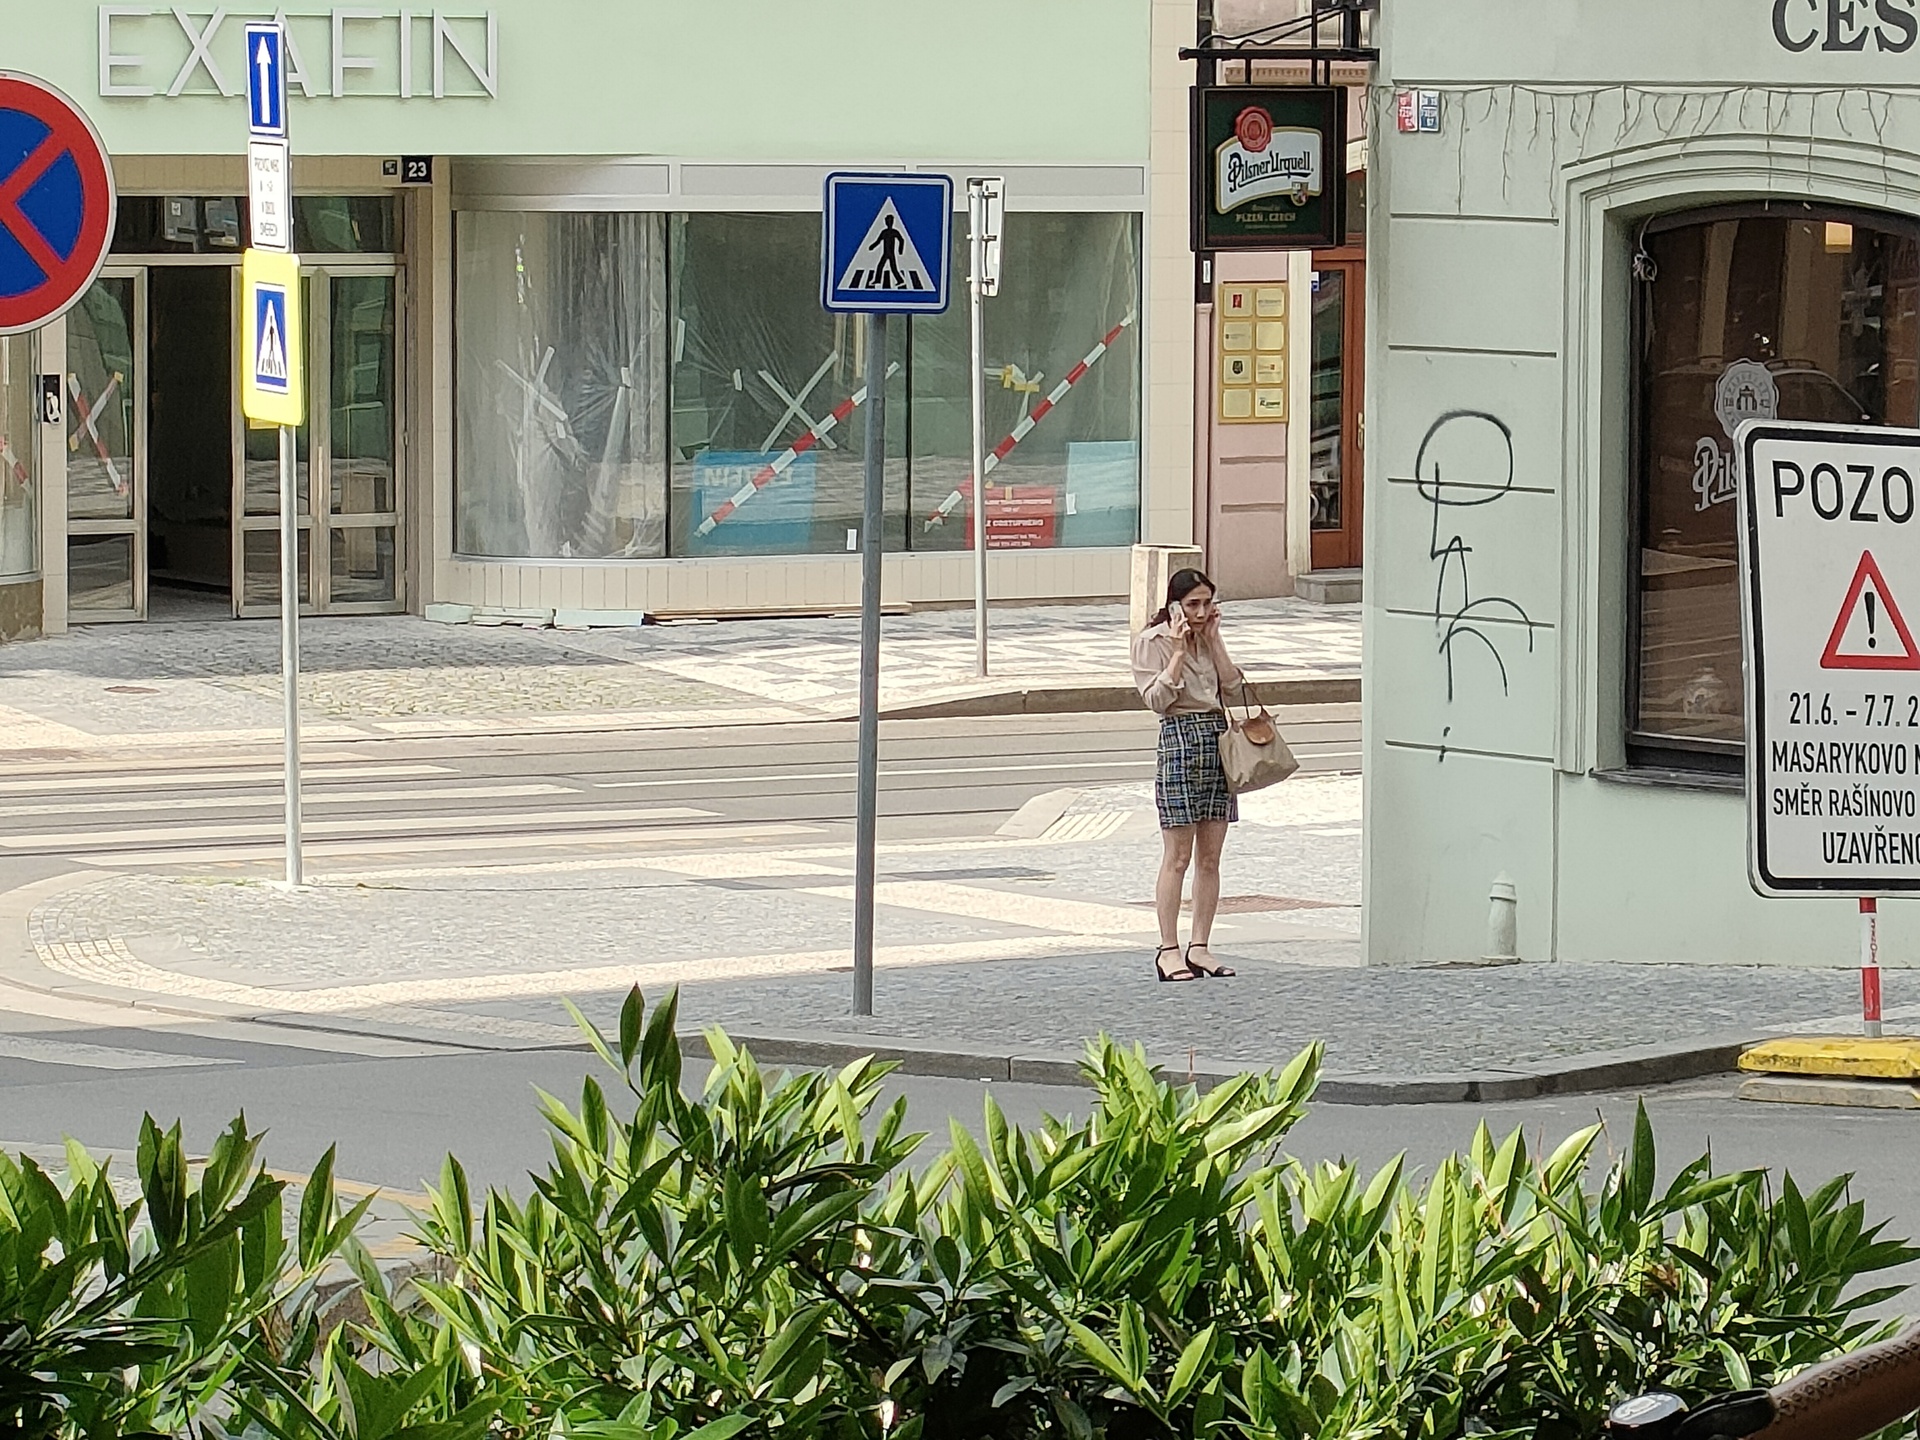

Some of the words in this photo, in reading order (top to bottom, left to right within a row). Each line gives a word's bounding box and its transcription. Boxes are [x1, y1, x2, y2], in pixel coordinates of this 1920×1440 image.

[99, 5, 498, 99] EXAFIN
[408, 161, 428, 178] 23
[1228, 151, 1271, 193] Pilsner
[1268, 150, 1311, 180] Urquell
[1771, 740, 1908, 775] MASARYKOVO
[1773, 781, 1823, 817] SMĚR
[1828, 782, 1916, 818] RAŠÍNOVO
